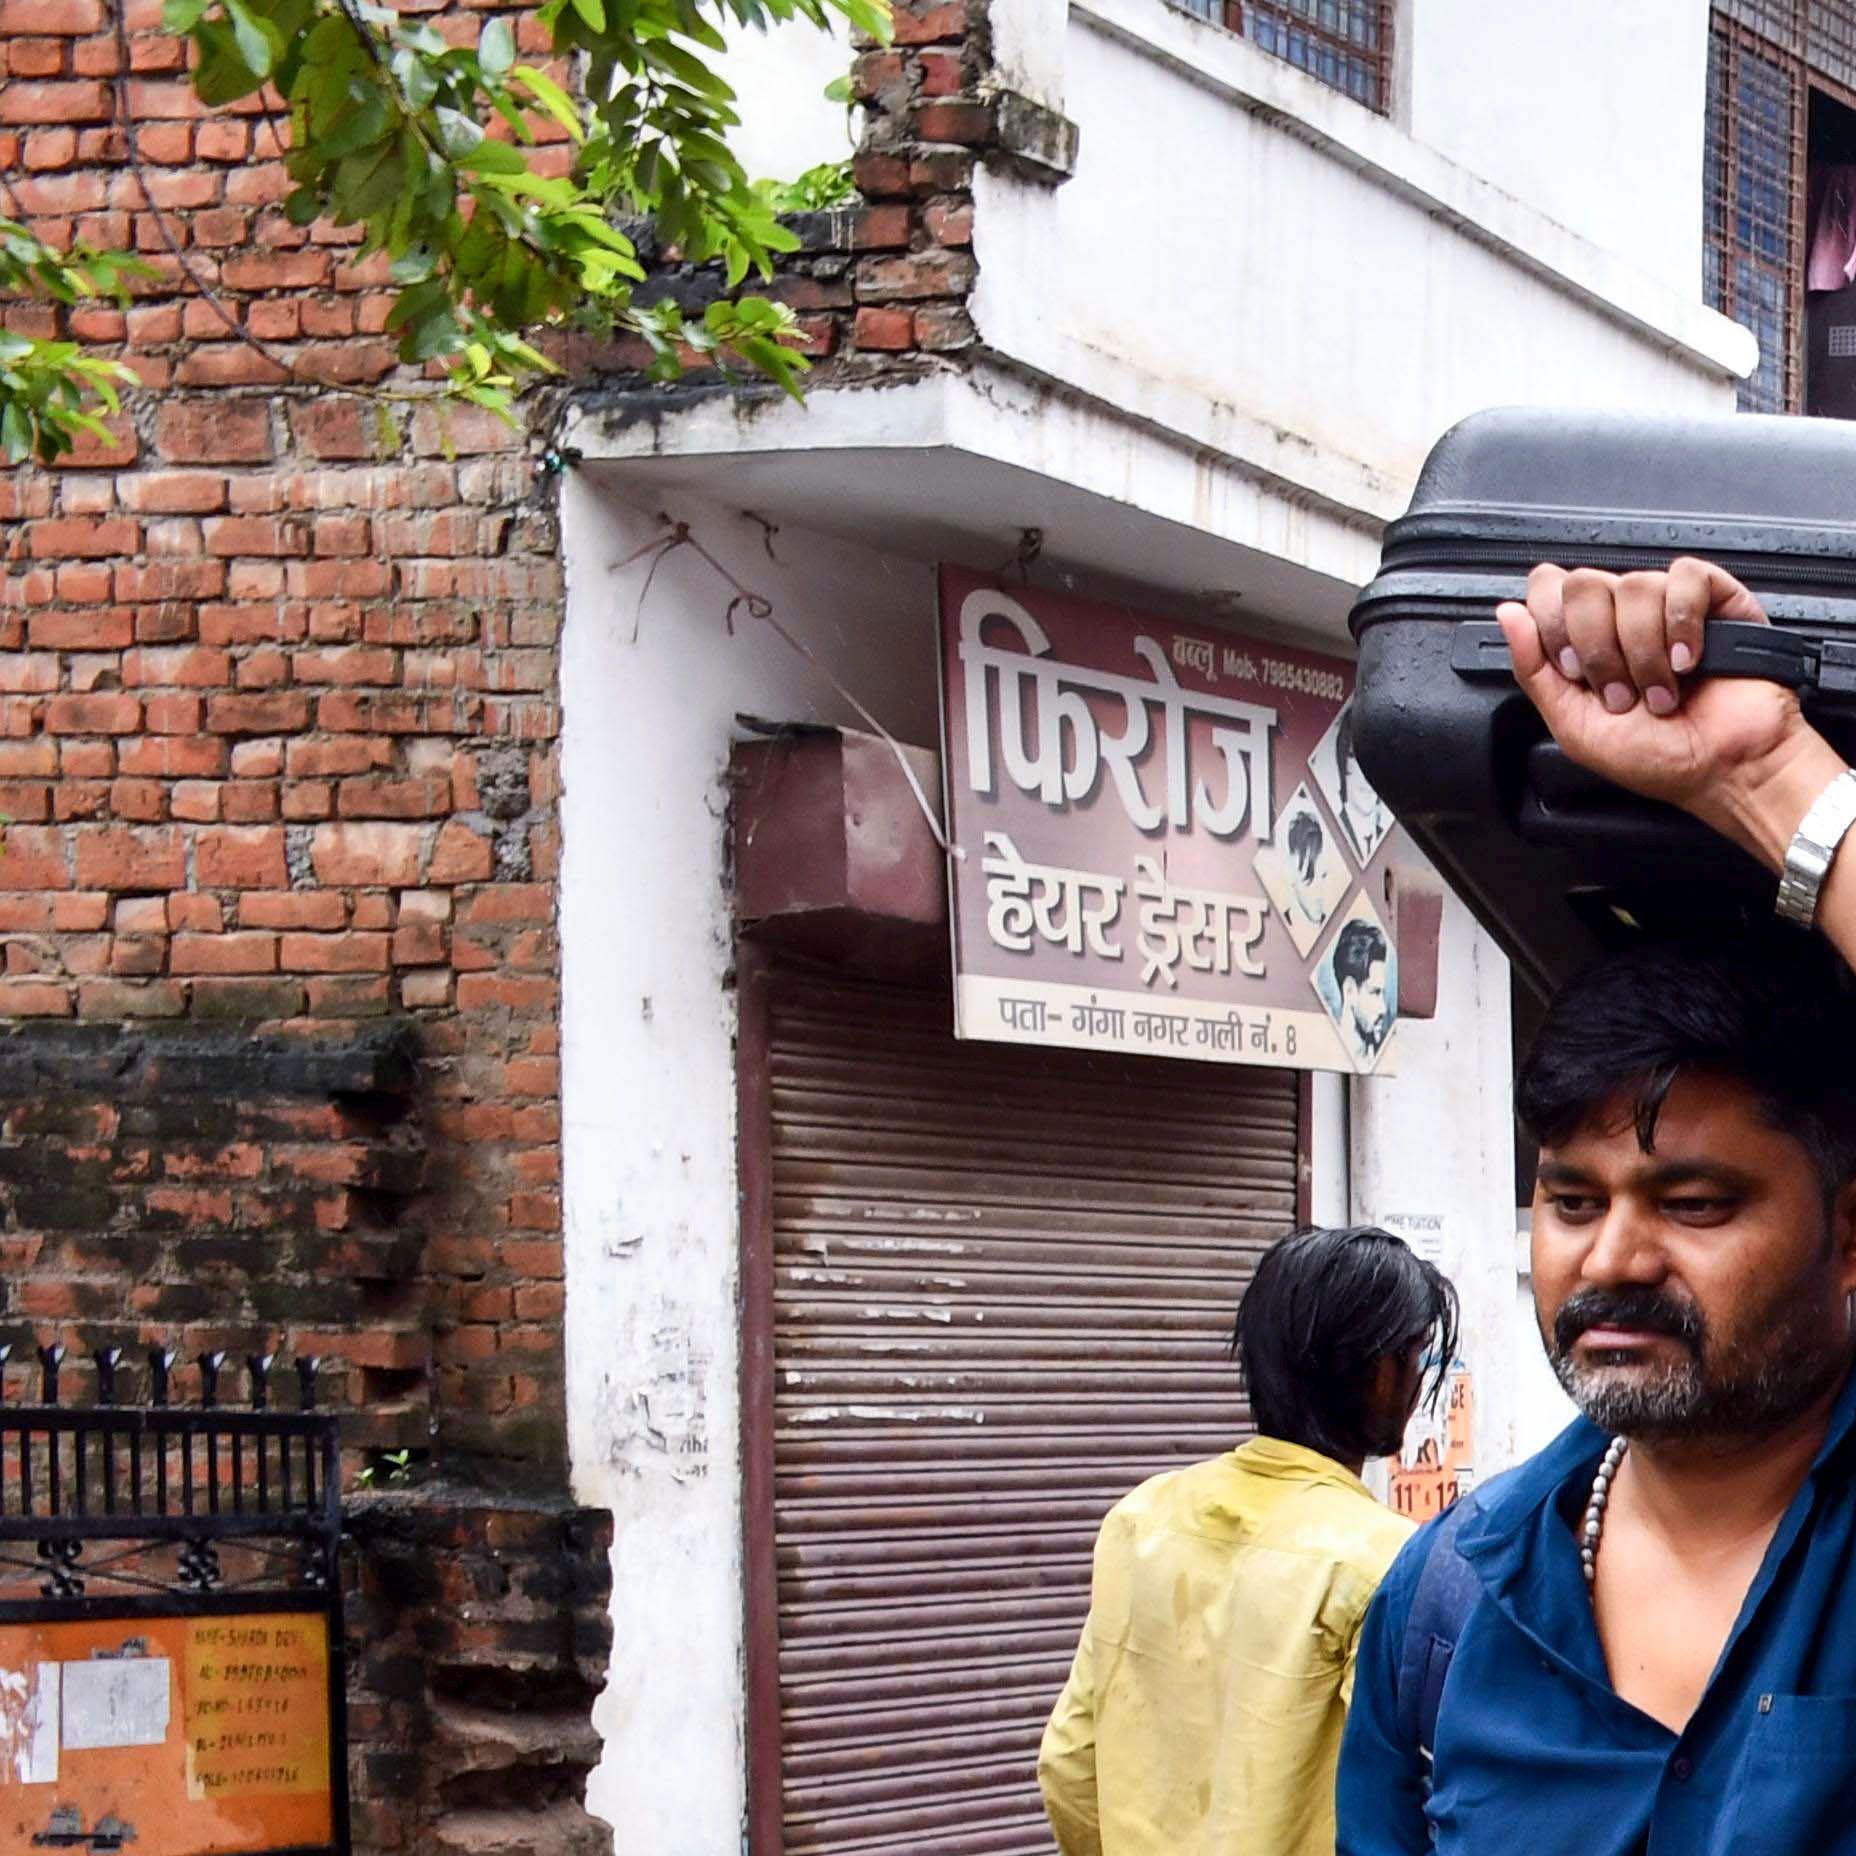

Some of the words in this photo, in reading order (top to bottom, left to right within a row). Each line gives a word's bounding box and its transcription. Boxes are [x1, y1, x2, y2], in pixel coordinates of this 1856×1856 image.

[958, 589, 1278, 842] फिरोज
[1261, 658, 1344, 701] 7985430882
[982, 831, 1126, 960] हेयर
[1071, 995, 1124, 1040] गंगा
[1133, 1012, 1190, 1047] नगर
[1195, 1012, 1243, 1052] गली
[1285, 1025, 1297, 1056] 8
